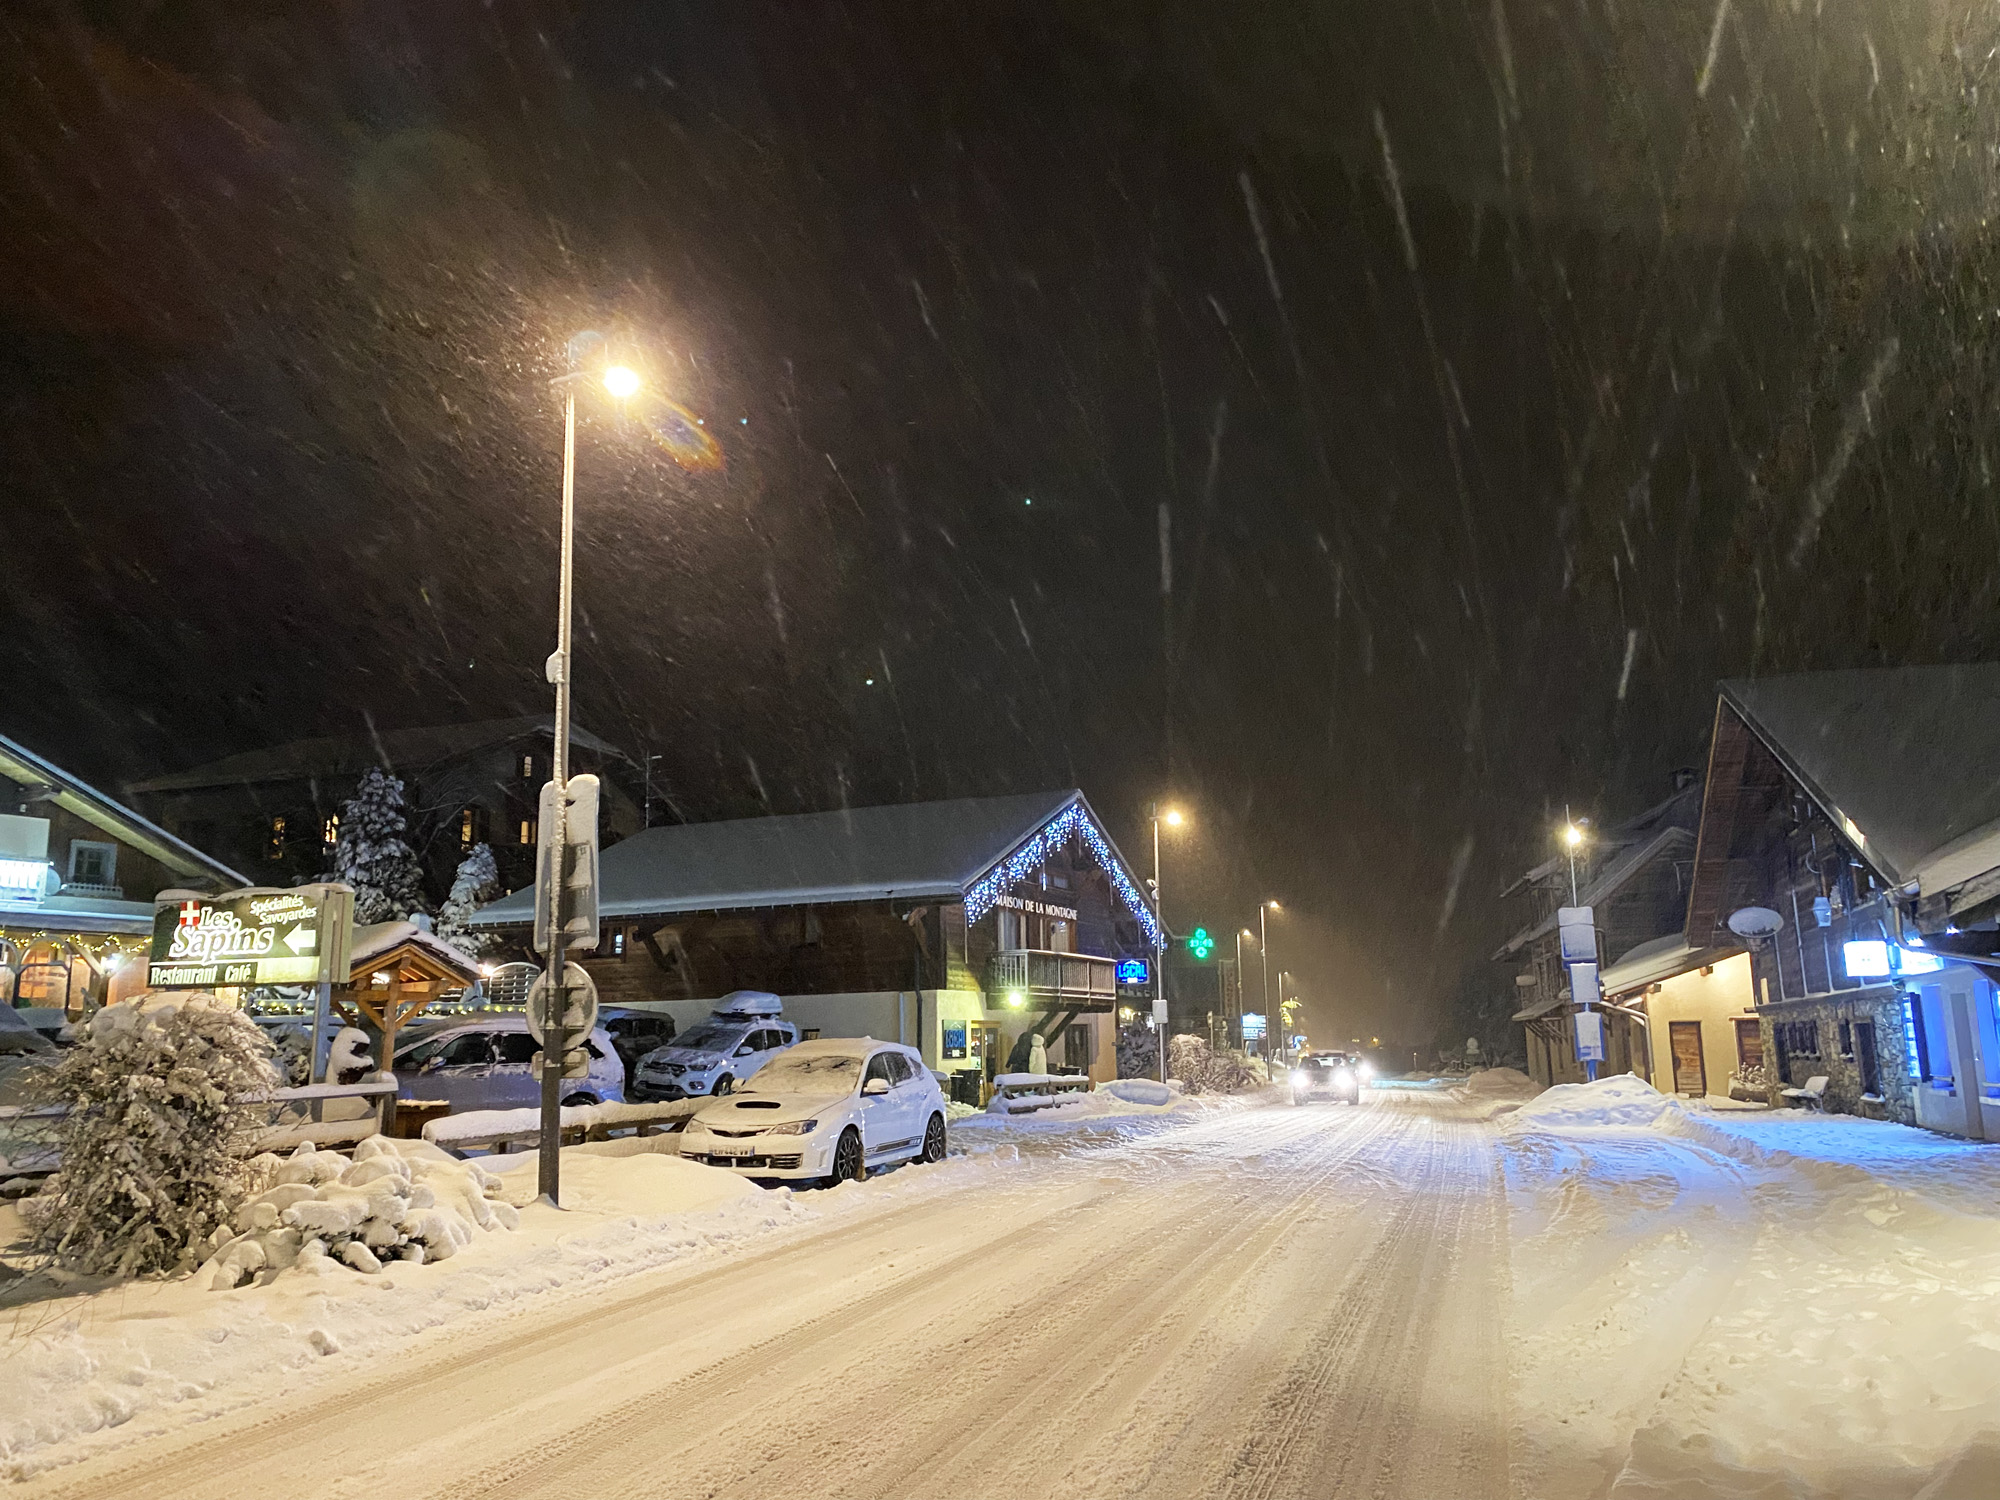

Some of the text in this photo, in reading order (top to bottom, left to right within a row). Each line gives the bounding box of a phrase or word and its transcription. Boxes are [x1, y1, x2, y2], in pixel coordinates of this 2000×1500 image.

[250, 894, 304, 916] Spécialités
[259, 905, 318, 925] Savoyardes
[996, 895, 1078, 920] MAISON DE LA MONTAGNE
[201, 907, 233, 928] Les
[169, 918, 275, 965] Sapins
[150, 963, 251, 985] Restaurant Café
[1118, 964, 1147, 977] LOCAL
